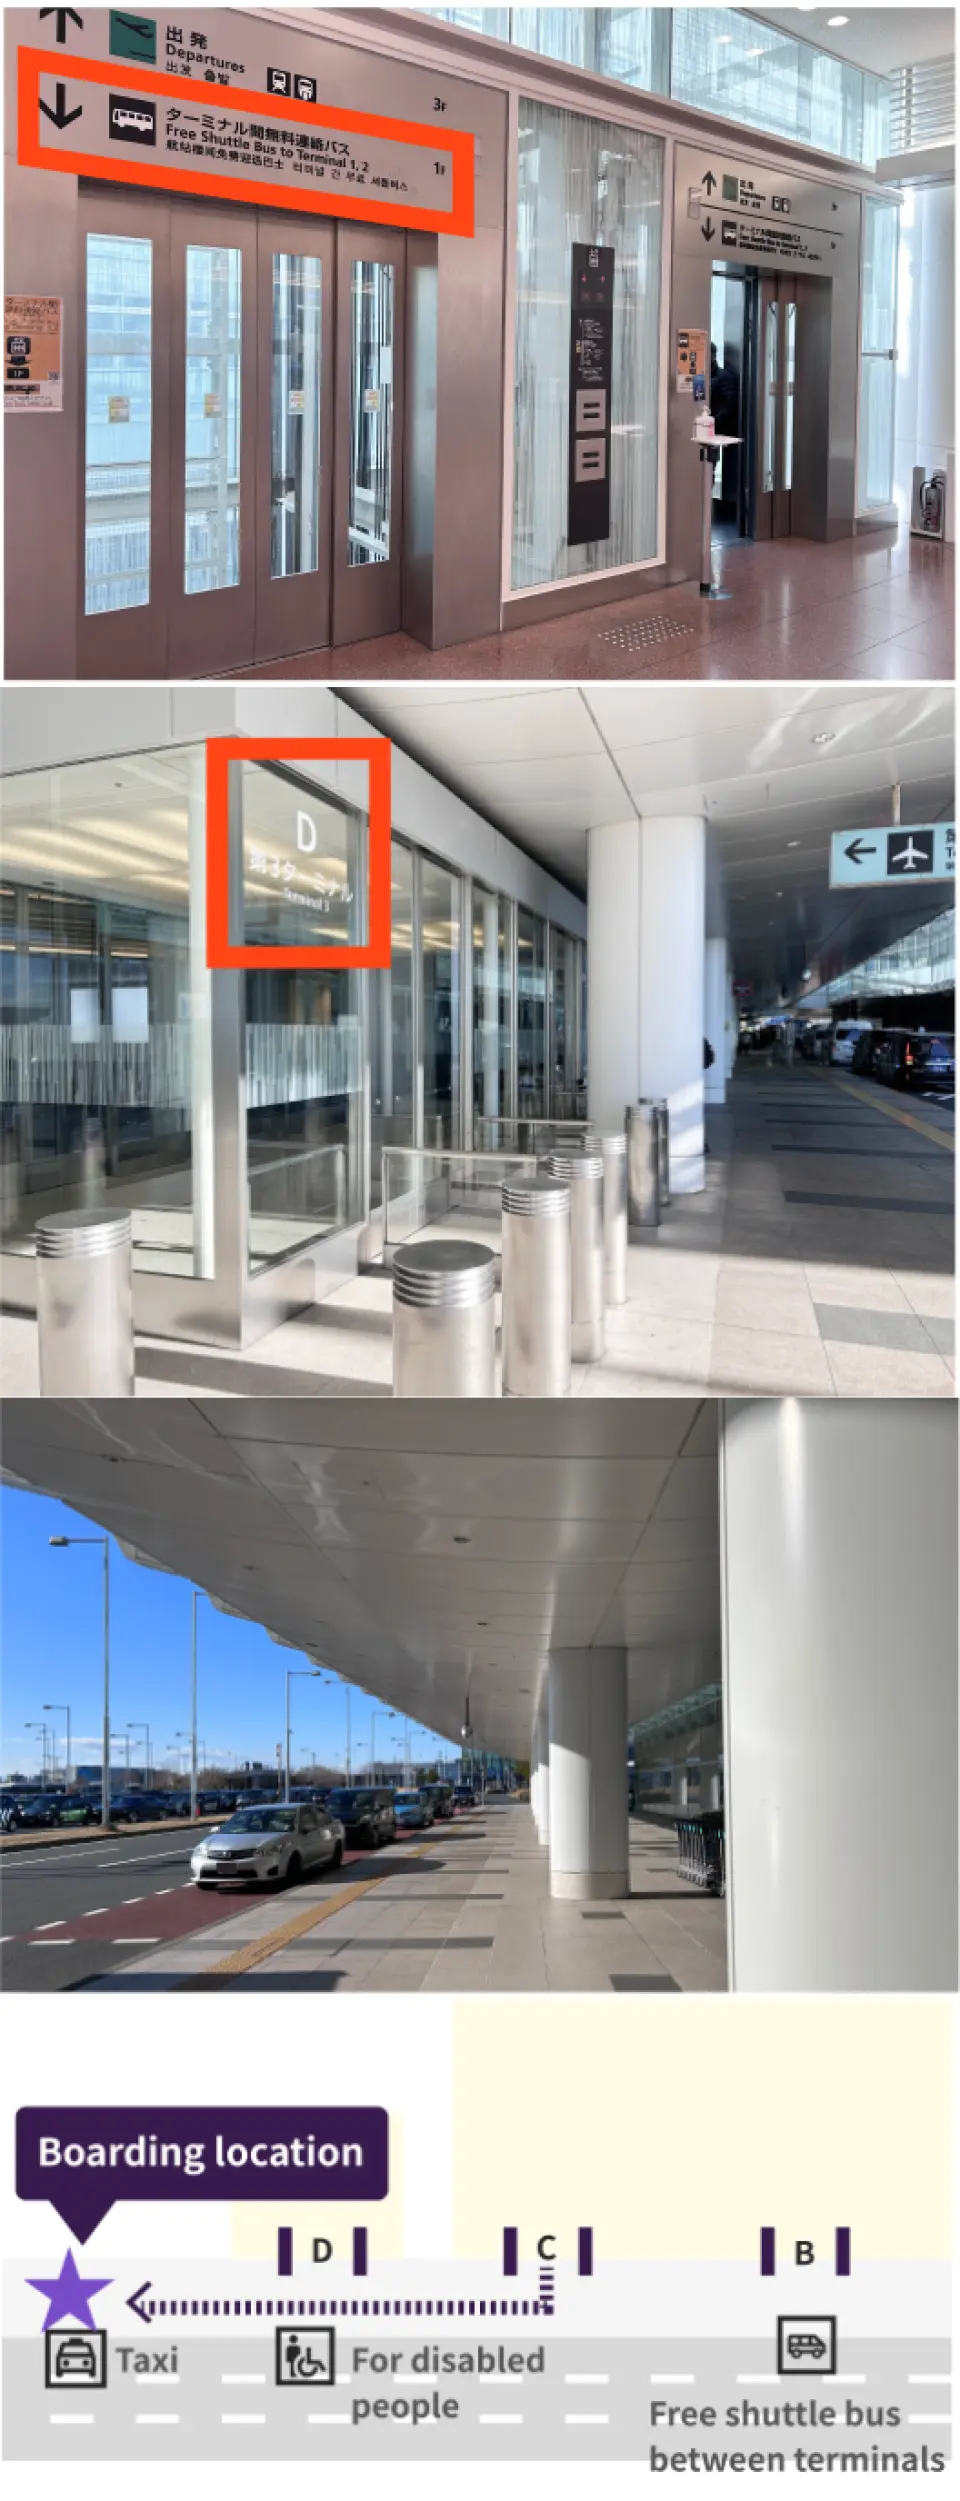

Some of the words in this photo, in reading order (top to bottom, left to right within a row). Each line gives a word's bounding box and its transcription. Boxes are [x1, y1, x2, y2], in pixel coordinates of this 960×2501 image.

[166, 43, 246, 74] Departures
[432, 97, 448, 112] 3F
[166, 107, 350, 157] ターミナル間無料連絡バス
[166, 123, 197, 141] Free
[201, 130, 250, 151] Shuttle
[254, 141, 277, 156] Bus
[280, 146, 294, 159] to
[296, 148, 347, 169] Terminal
[433, 161, 446, 176] 1F
[297, 810, 318, 852] D
[284, 886, 323, 911] Terminal
